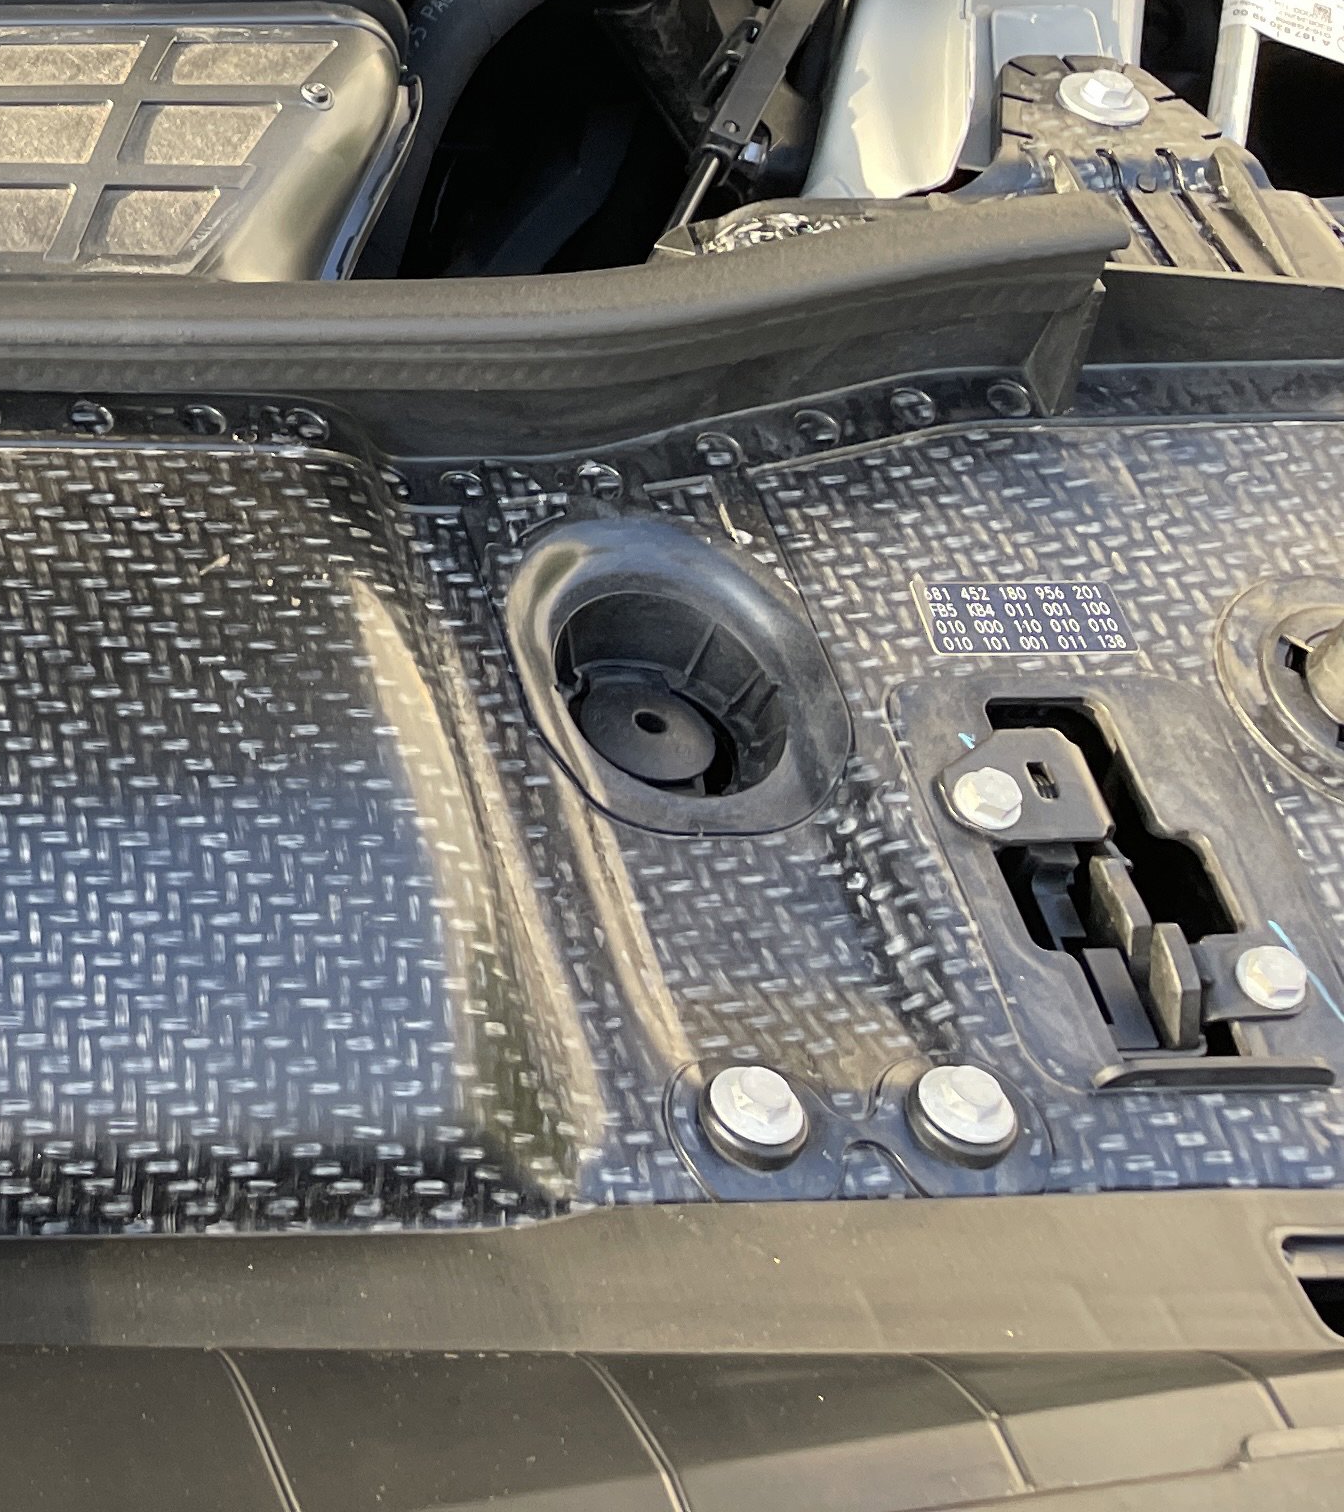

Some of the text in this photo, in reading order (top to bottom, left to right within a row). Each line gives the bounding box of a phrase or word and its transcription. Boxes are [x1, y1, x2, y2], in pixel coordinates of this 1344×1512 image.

[961, 587, 990, 601] 452
[999, 586, 1027, 601] 180
[1035, 586, 1065, 600] 956
[1072, 585, 1102, 600] 201
[930, 601, 1111, 618] FB5 KB4 011 001 100
[936, 617, 1119, 635] 010 000 110 010 010
[943, 634, 1127, 652] 010 101 001 011 138
